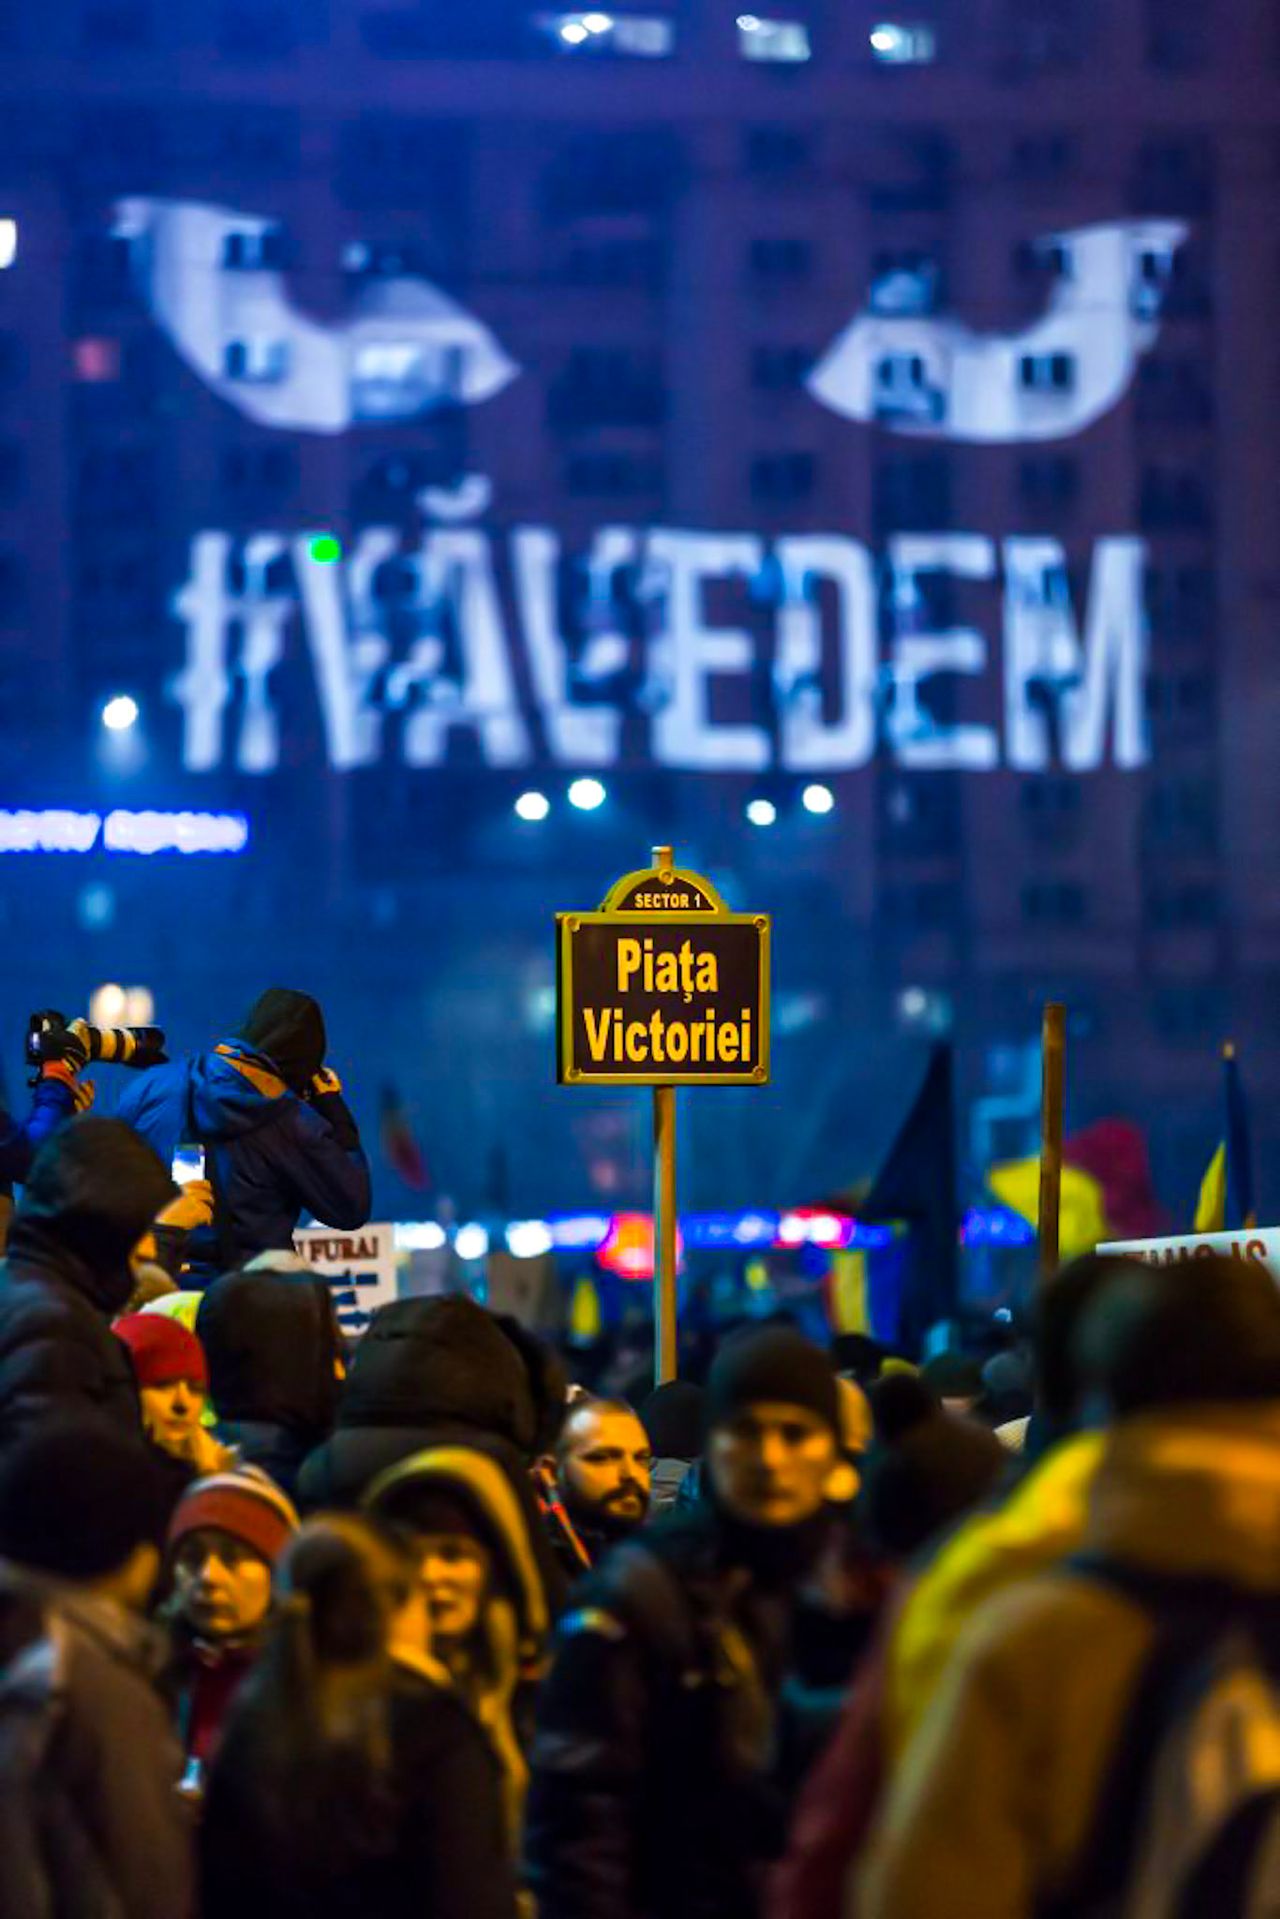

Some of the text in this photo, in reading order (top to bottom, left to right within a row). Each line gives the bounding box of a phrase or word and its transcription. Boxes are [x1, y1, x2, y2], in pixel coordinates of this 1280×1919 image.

[634, 893, 701, 909] SECTOR 1
[582, 1007, 751, 1063] Victoriei
